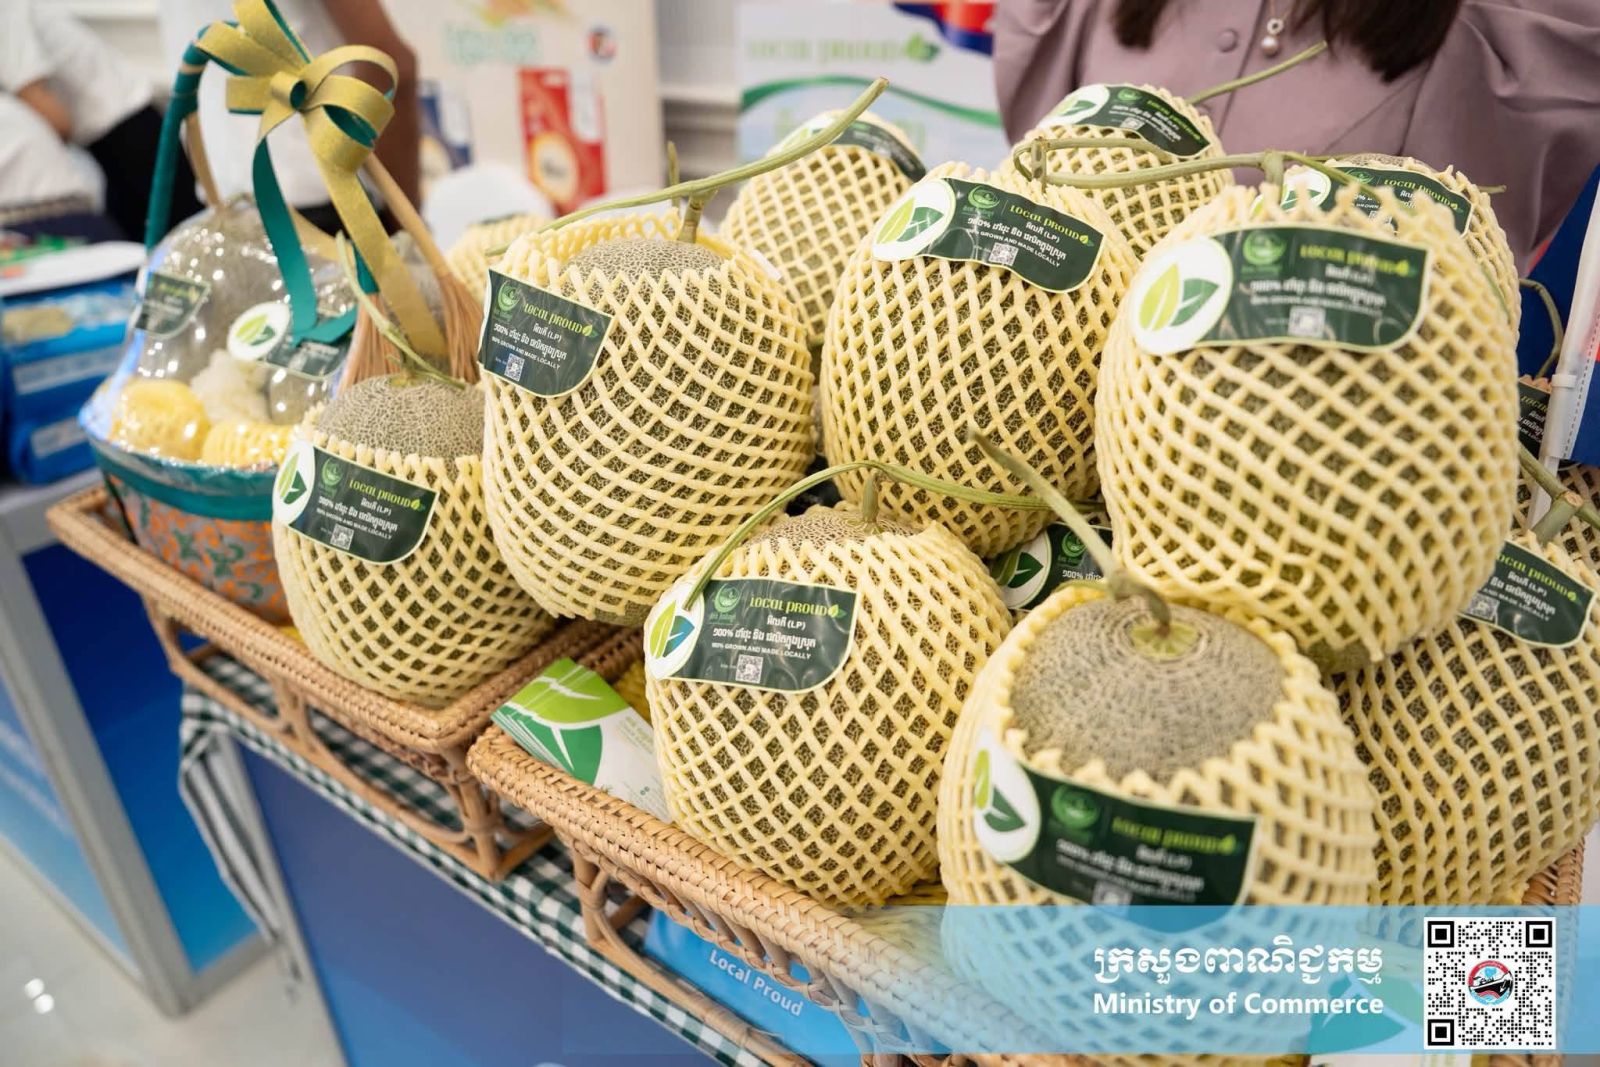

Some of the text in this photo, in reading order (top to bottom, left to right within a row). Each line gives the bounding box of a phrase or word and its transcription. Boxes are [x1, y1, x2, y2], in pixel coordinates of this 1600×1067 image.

[1498, 553, 1526, 573] OCAL
[787, 618, 806, 631] (LP)
[709, 949, 804, 1017] Local Proud
